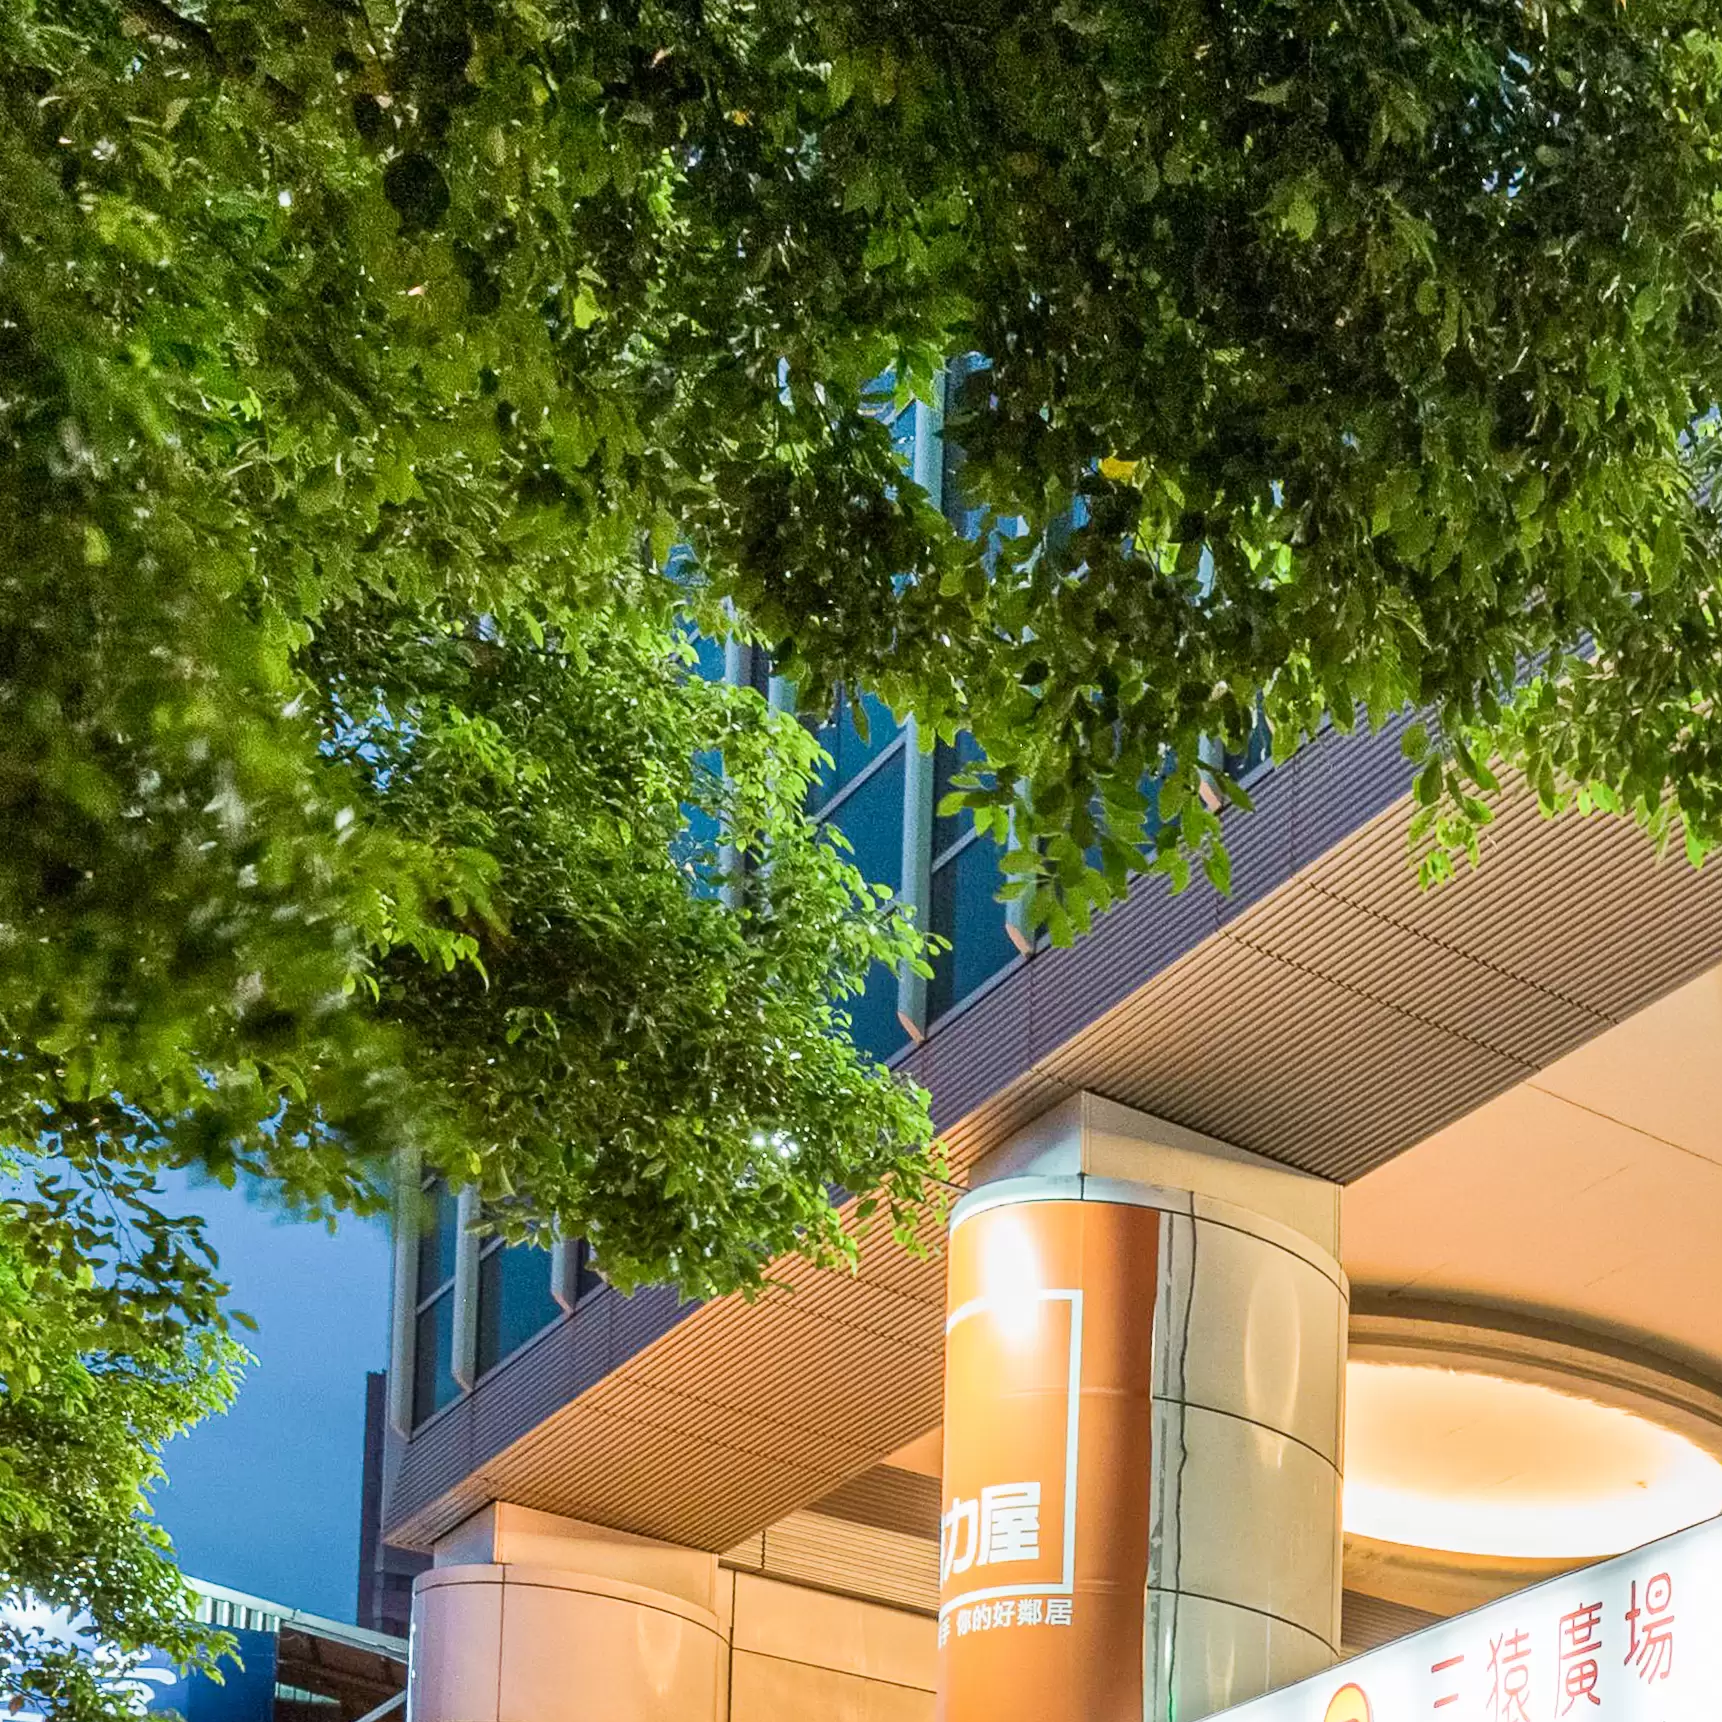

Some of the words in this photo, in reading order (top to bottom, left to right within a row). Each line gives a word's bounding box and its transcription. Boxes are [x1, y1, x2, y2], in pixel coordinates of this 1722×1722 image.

[956, 1598, 1073, 1637] 你的好鄰居
